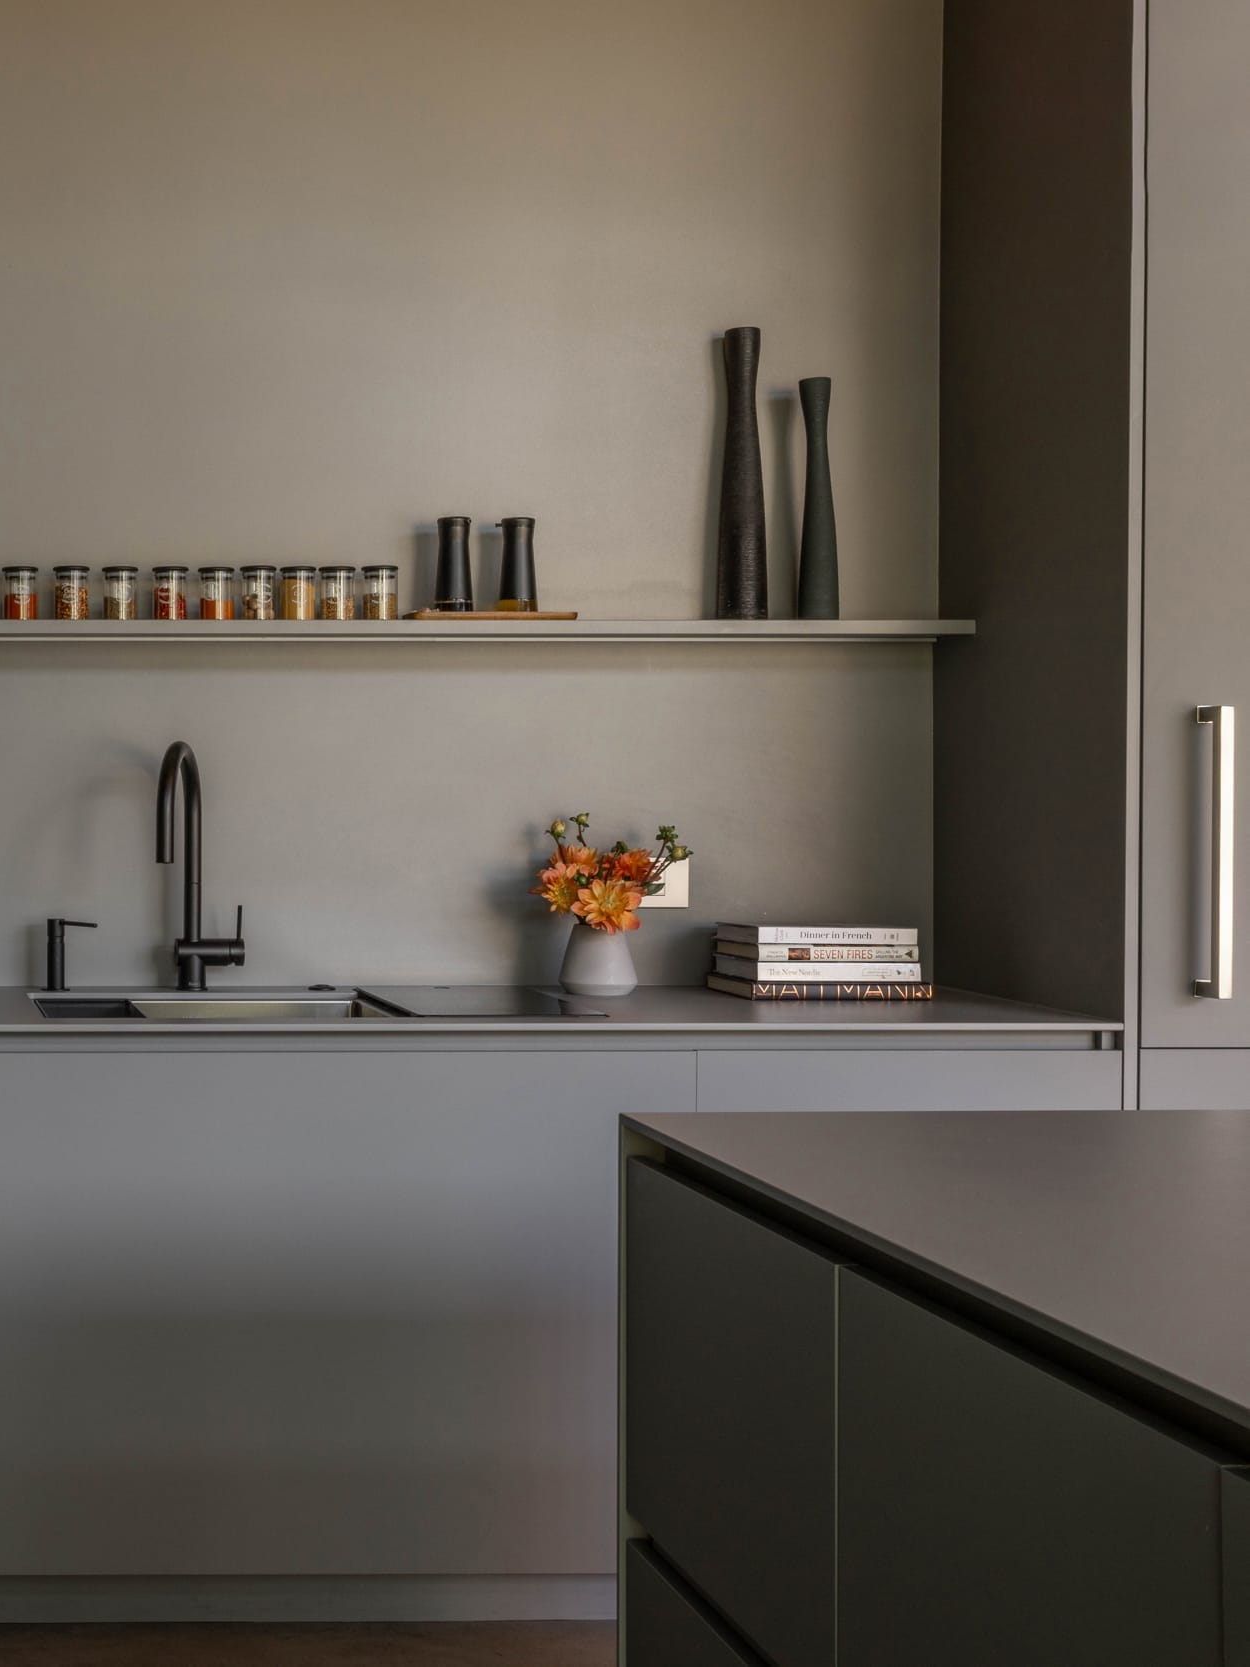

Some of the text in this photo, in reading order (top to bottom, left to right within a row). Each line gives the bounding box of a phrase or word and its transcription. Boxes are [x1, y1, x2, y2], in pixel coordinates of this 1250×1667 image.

[800, 931, 872, 940] Dinner in French
[813, 949, 844, 960] SEVEN
[847, 949, 873, 960] FIRES
